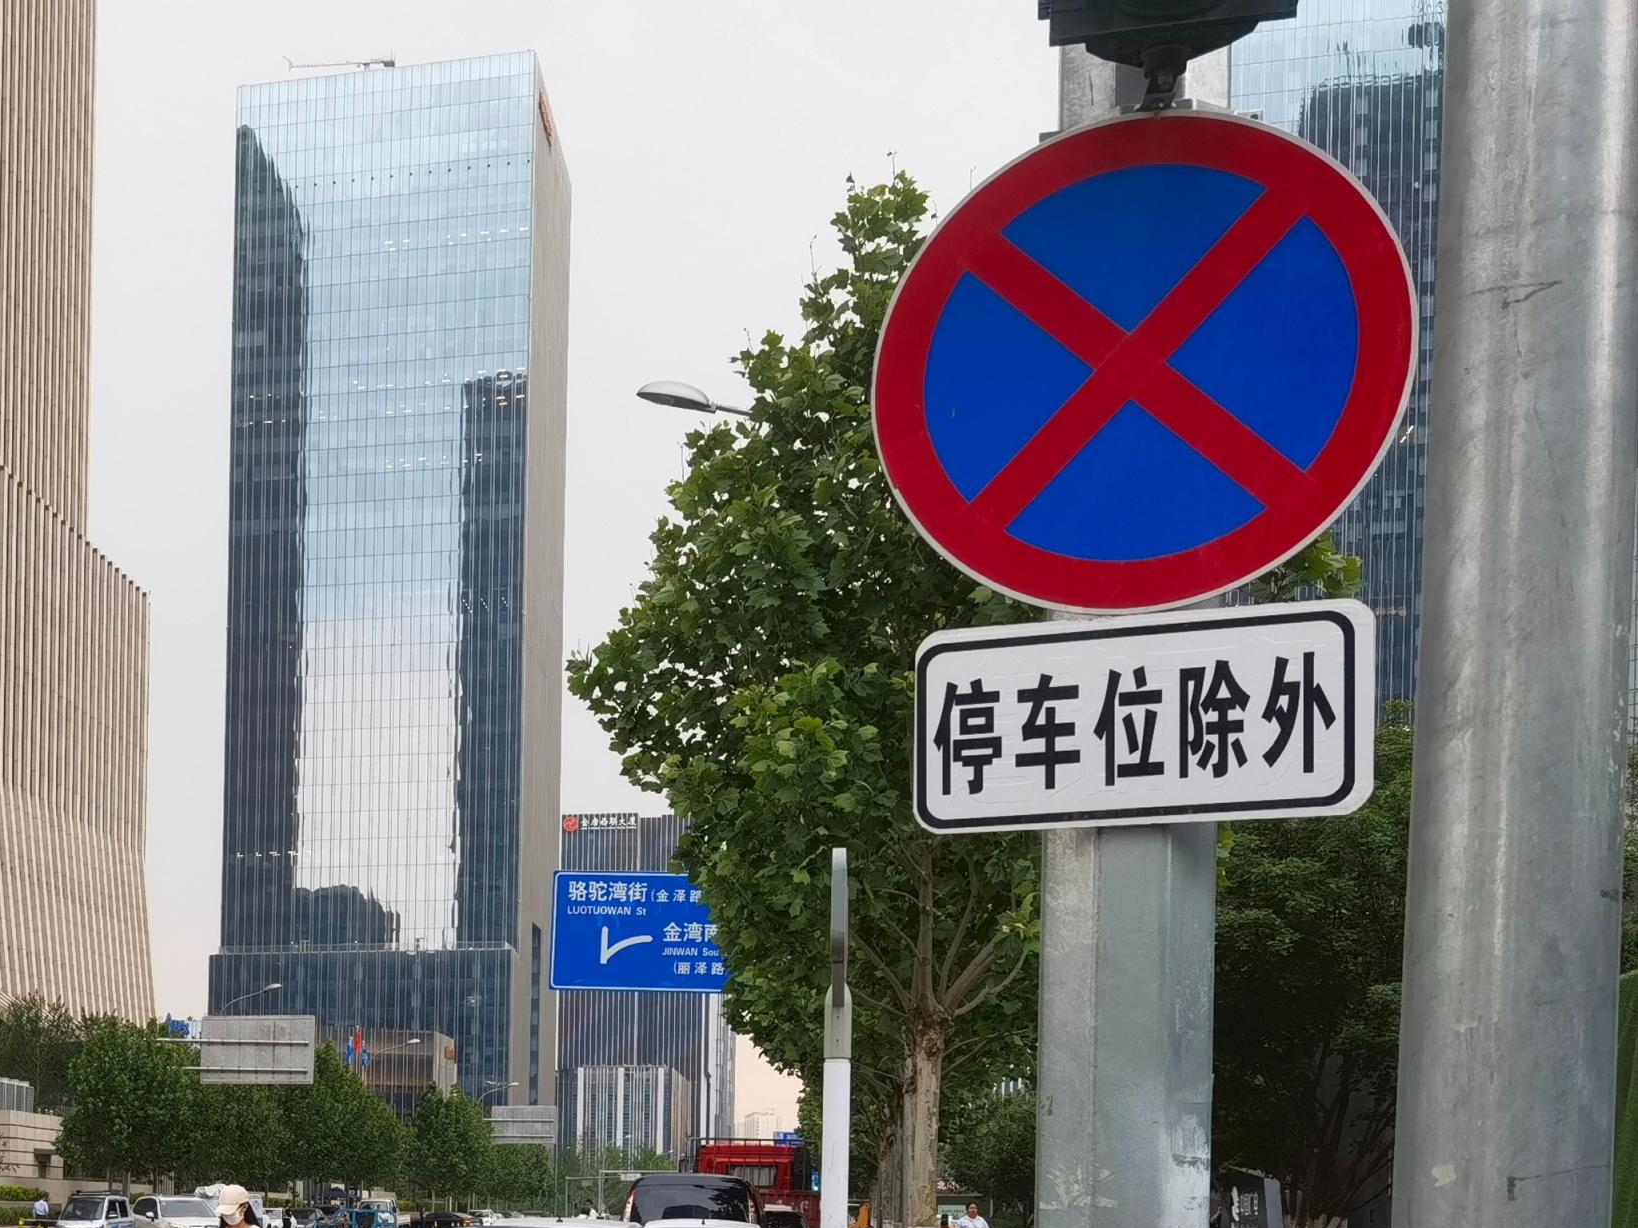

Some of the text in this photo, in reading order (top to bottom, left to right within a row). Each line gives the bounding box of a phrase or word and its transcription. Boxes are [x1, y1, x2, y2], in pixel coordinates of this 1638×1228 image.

[932, 651, 1337, 796] 停车位除外
[568, 881, 648, 902] 骆驼湾街
[567, 905, 647, 916] LUOTUOWAN St
[661, 947, 698, 957] JINWAN
